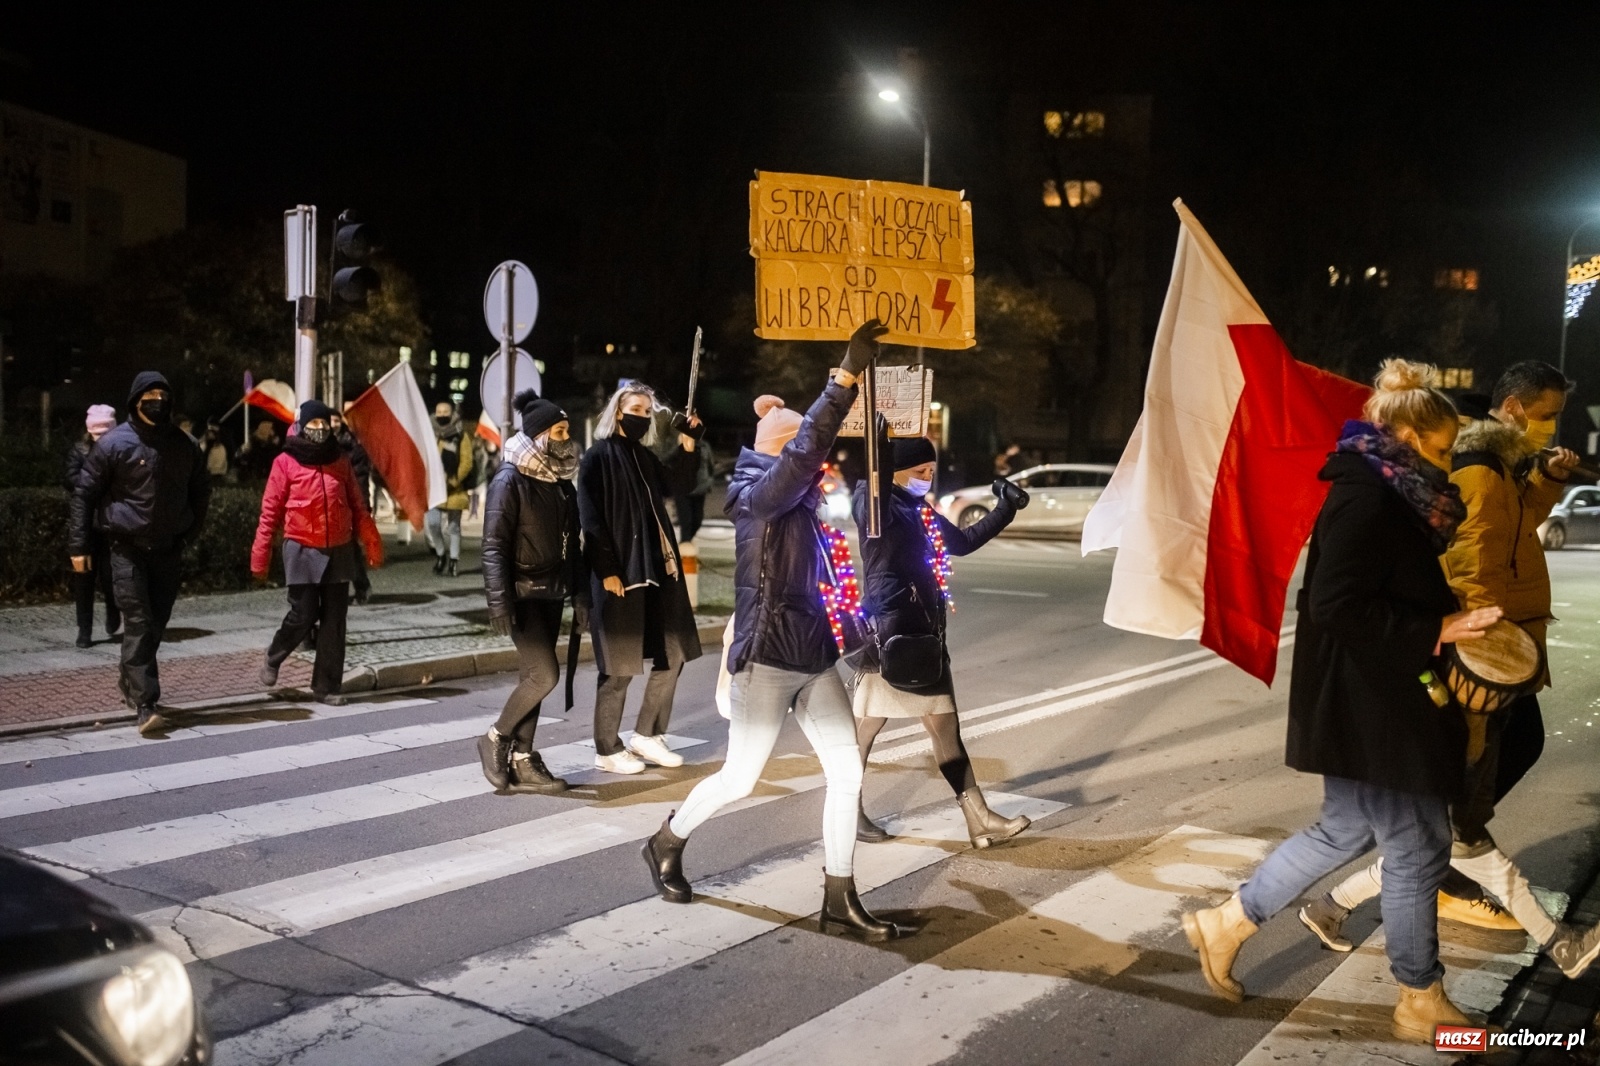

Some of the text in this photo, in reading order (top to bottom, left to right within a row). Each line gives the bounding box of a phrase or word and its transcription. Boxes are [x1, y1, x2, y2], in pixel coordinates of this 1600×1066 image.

[771, 188, 961, 239] STRACH W OCZACH
[764, 218, 946, 263] KACZORA LEPSZY
[844, 265, 877, 287] OD
[765, 286, 921, 334] WIBRATORA
